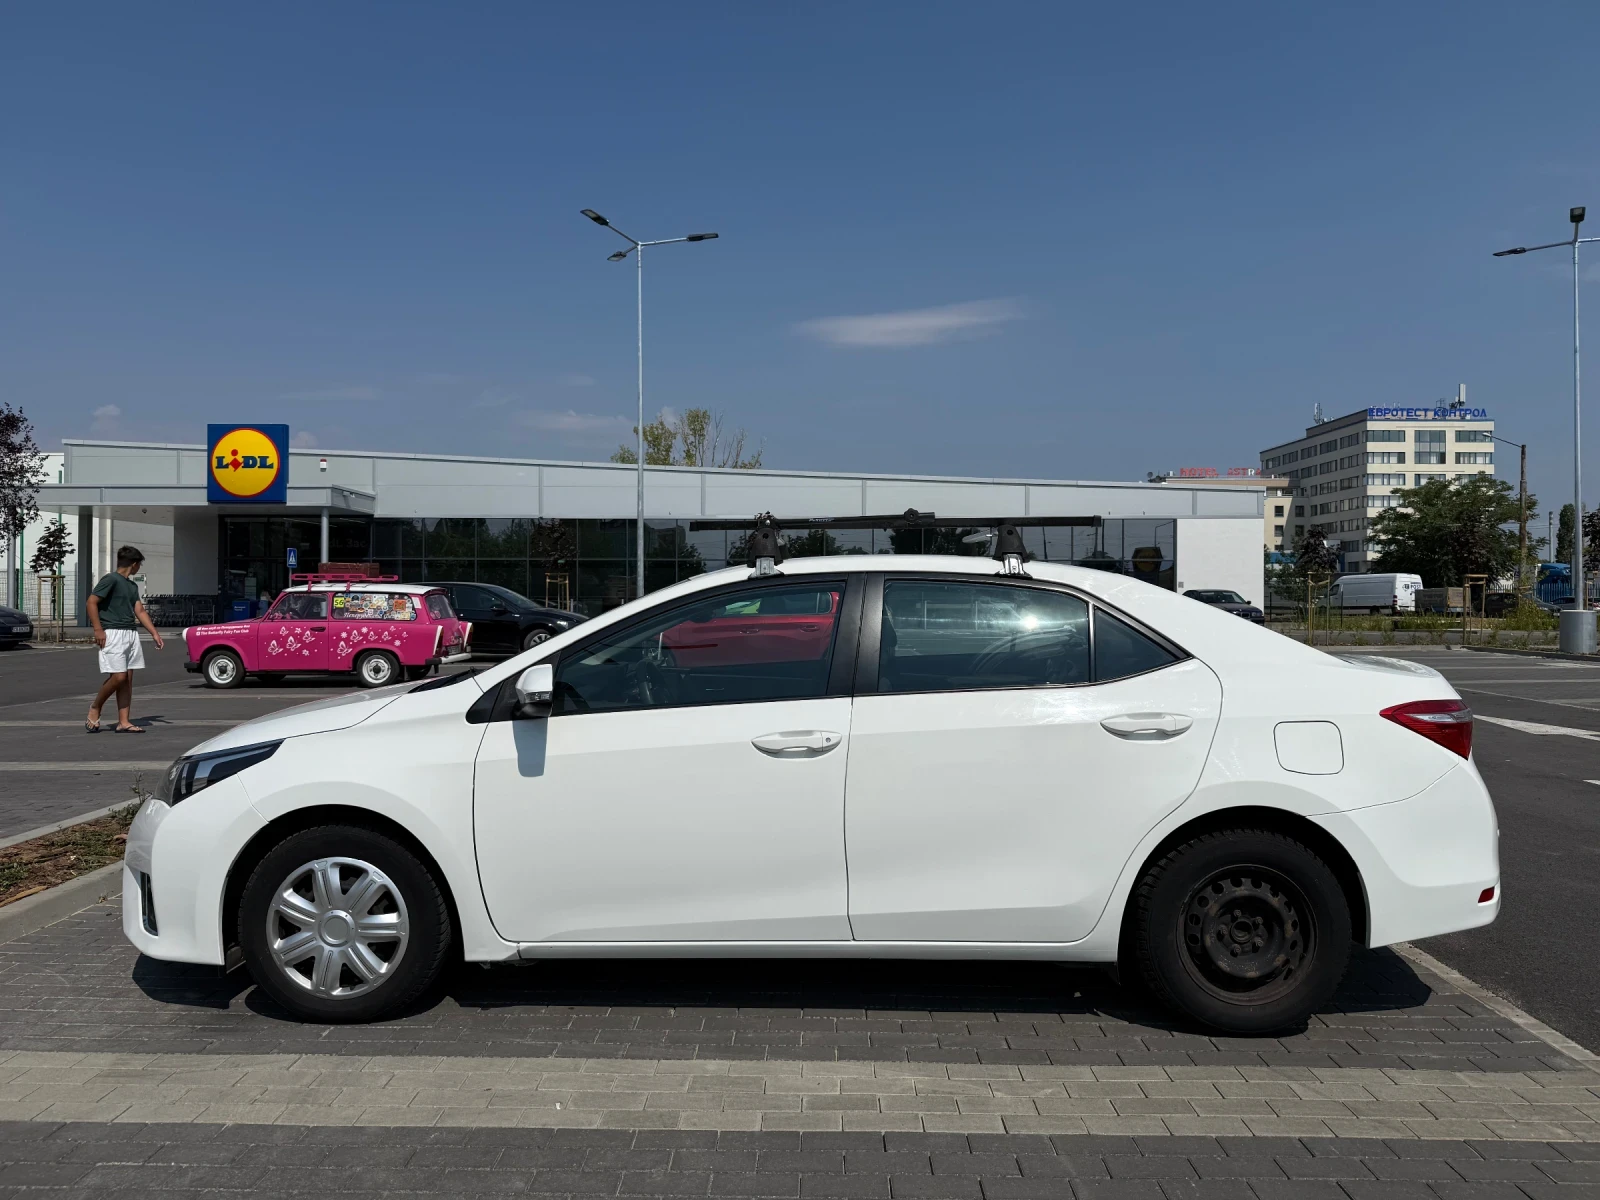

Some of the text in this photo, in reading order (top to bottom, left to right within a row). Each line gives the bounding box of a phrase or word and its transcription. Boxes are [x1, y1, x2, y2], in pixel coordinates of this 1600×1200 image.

[1368, 407, 1487, 418] ЕВРОТЕСТ КОНТРОЛ
[1180, 467, 1219, 477] HOTEL
